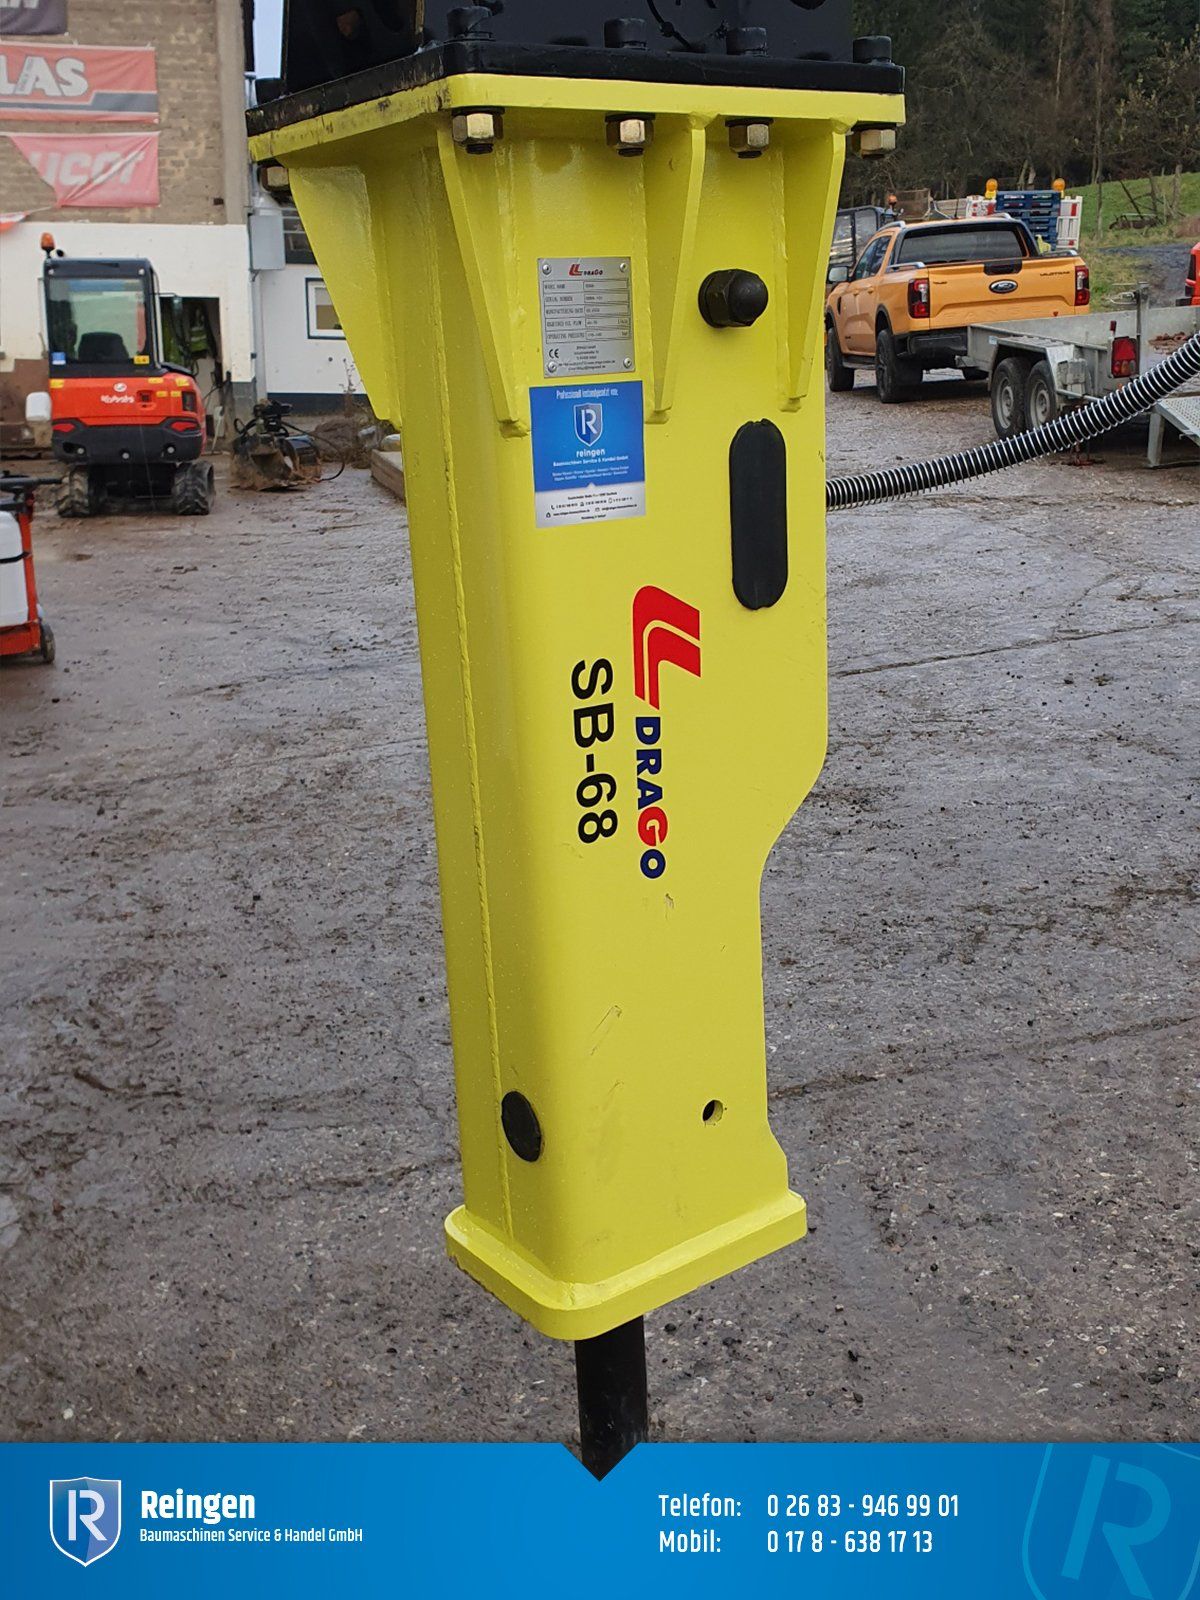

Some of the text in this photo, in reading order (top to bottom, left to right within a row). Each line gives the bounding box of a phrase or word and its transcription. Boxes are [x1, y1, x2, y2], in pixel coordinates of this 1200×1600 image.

[576, 448, 606, 459] reingen
[571, 658, 618, 844] SB-68
[634, 716, 668, 879] DRAGO
